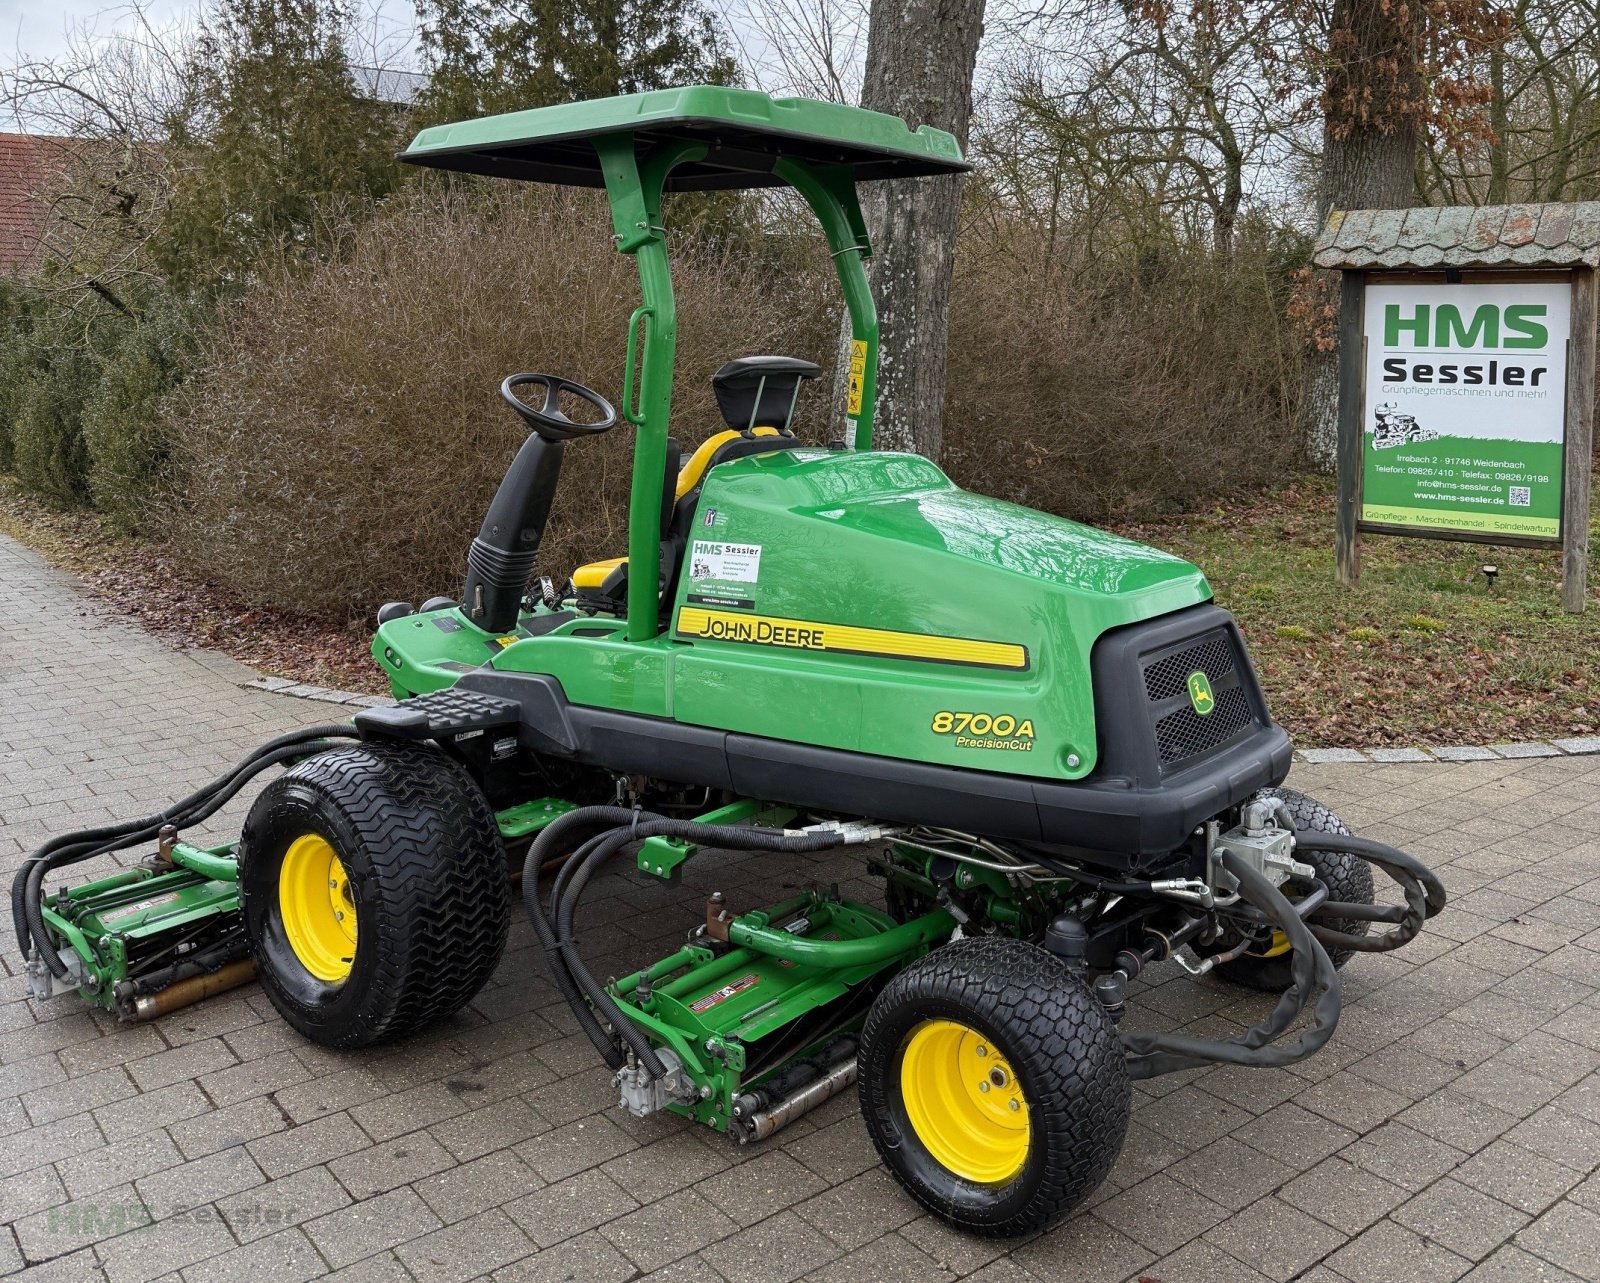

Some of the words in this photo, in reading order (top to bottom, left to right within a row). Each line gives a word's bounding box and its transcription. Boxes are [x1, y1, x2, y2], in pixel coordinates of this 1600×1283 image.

[1384, 303, 1548, 349] HMS
[1383, 358, 1547, 386] Sessler
[1382, 385, 1491, 397] Grünpflegemaschinen
[1494, 389, 1514, 398] und
[1517, 390, 1547, 399] mehr!
[1396, 455, 1430, 464] Irrebach
[1432, 456, 1438, 464] 2
[1445, 457, 1471, 466] 91746
[1473, 459, 1525, 469] Weidenbach
[1375, 465, 1406, 474] Telefon:
[1407, 467, 1454, 477] 09826/410
[1461, 470, 1493, 480] Telefax:
[1495, 472, 1549, 483] 09826/9198
[1417, 480, 1502, 492] info@hms-sessler.de
[1413, 492, 1505, 505] www.hms-sessler.de
[1365, 511, 1407, 522] Grünpflege
[1416, 515, 1485, 528] Maschinenhandel
[1494, 521, 1557, 535] Spindelwartung
[694, 543, 722, 555] HMS
[725, 545, 759, 555] Sessler
[699, 616, 751, 640] JOHN
[757, 621, 824, 646] DEERE
[931, 711, 1035, 738] 8700A
[956, 736, 1033, 751] PrecisionCut
